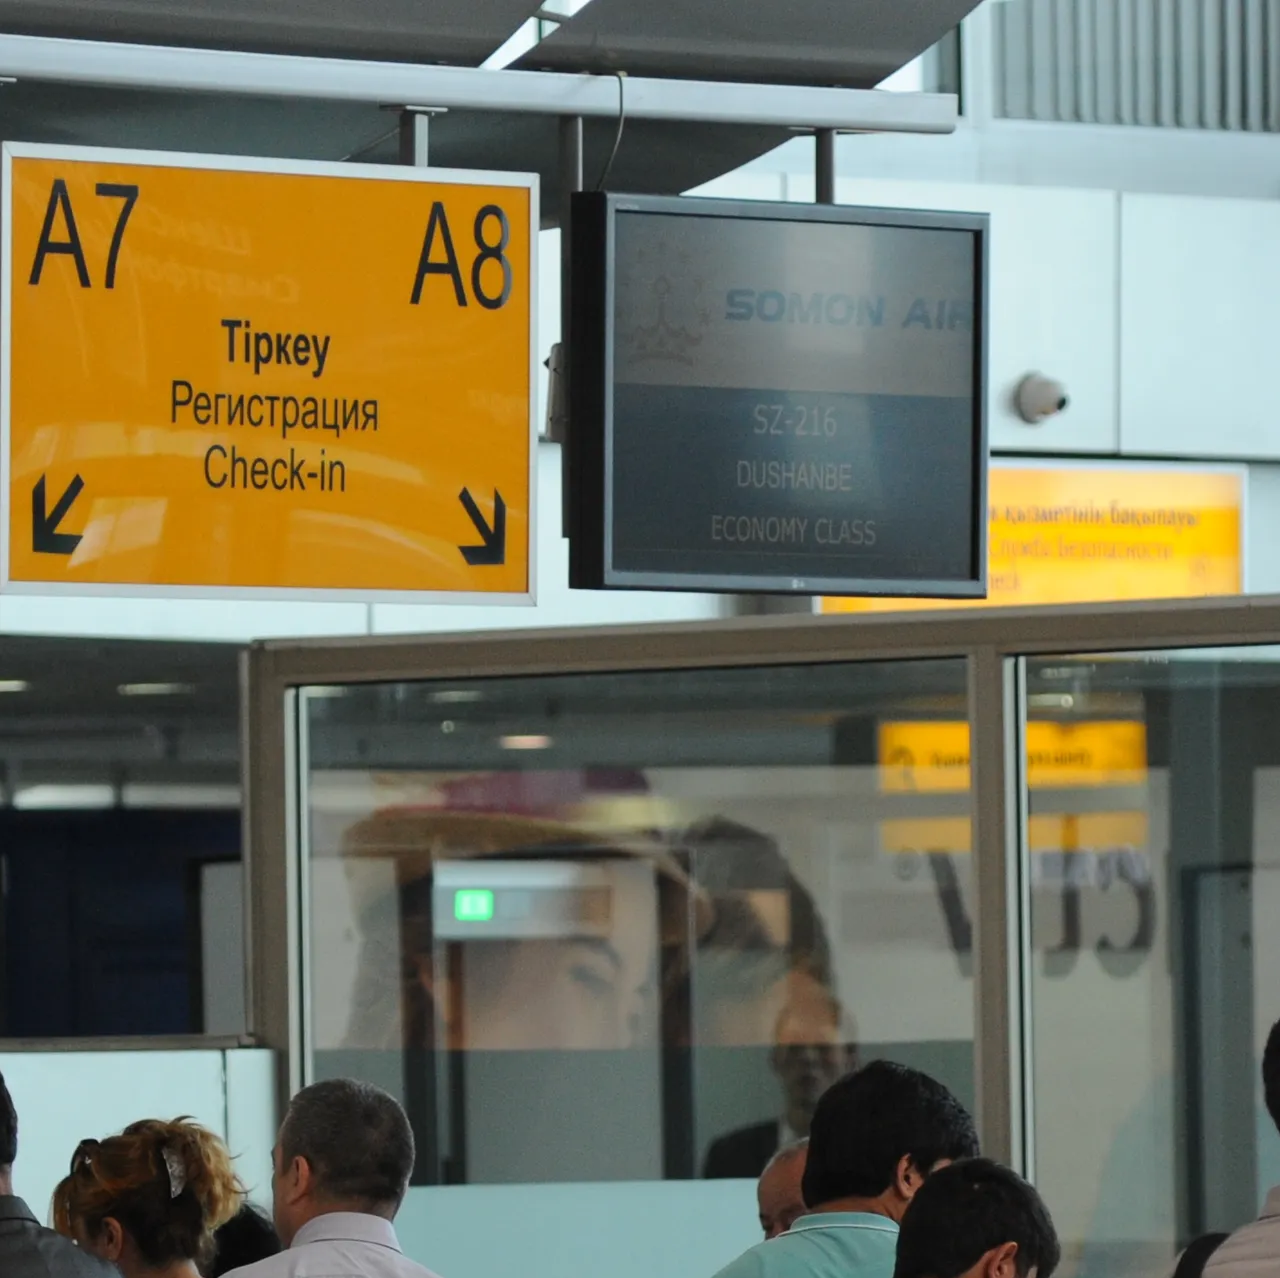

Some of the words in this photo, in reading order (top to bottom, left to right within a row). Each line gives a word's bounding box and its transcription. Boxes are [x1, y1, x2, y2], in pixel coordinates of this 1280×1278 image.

[28, 178, 140, 289] A7
[410, 201, 513, 310] A8
[724, 287, 885, 328] SOMON
[171, 380, 379, 438] Регистрация
[752, 405, 838, 439] SZ-216
[204, 445, 346, 492] Check-in
[737, 461, 852, 492] DUSHANBE
[710, 515, 808, 544] ECONOMY
[815, 519, 876, 546] CLASS
